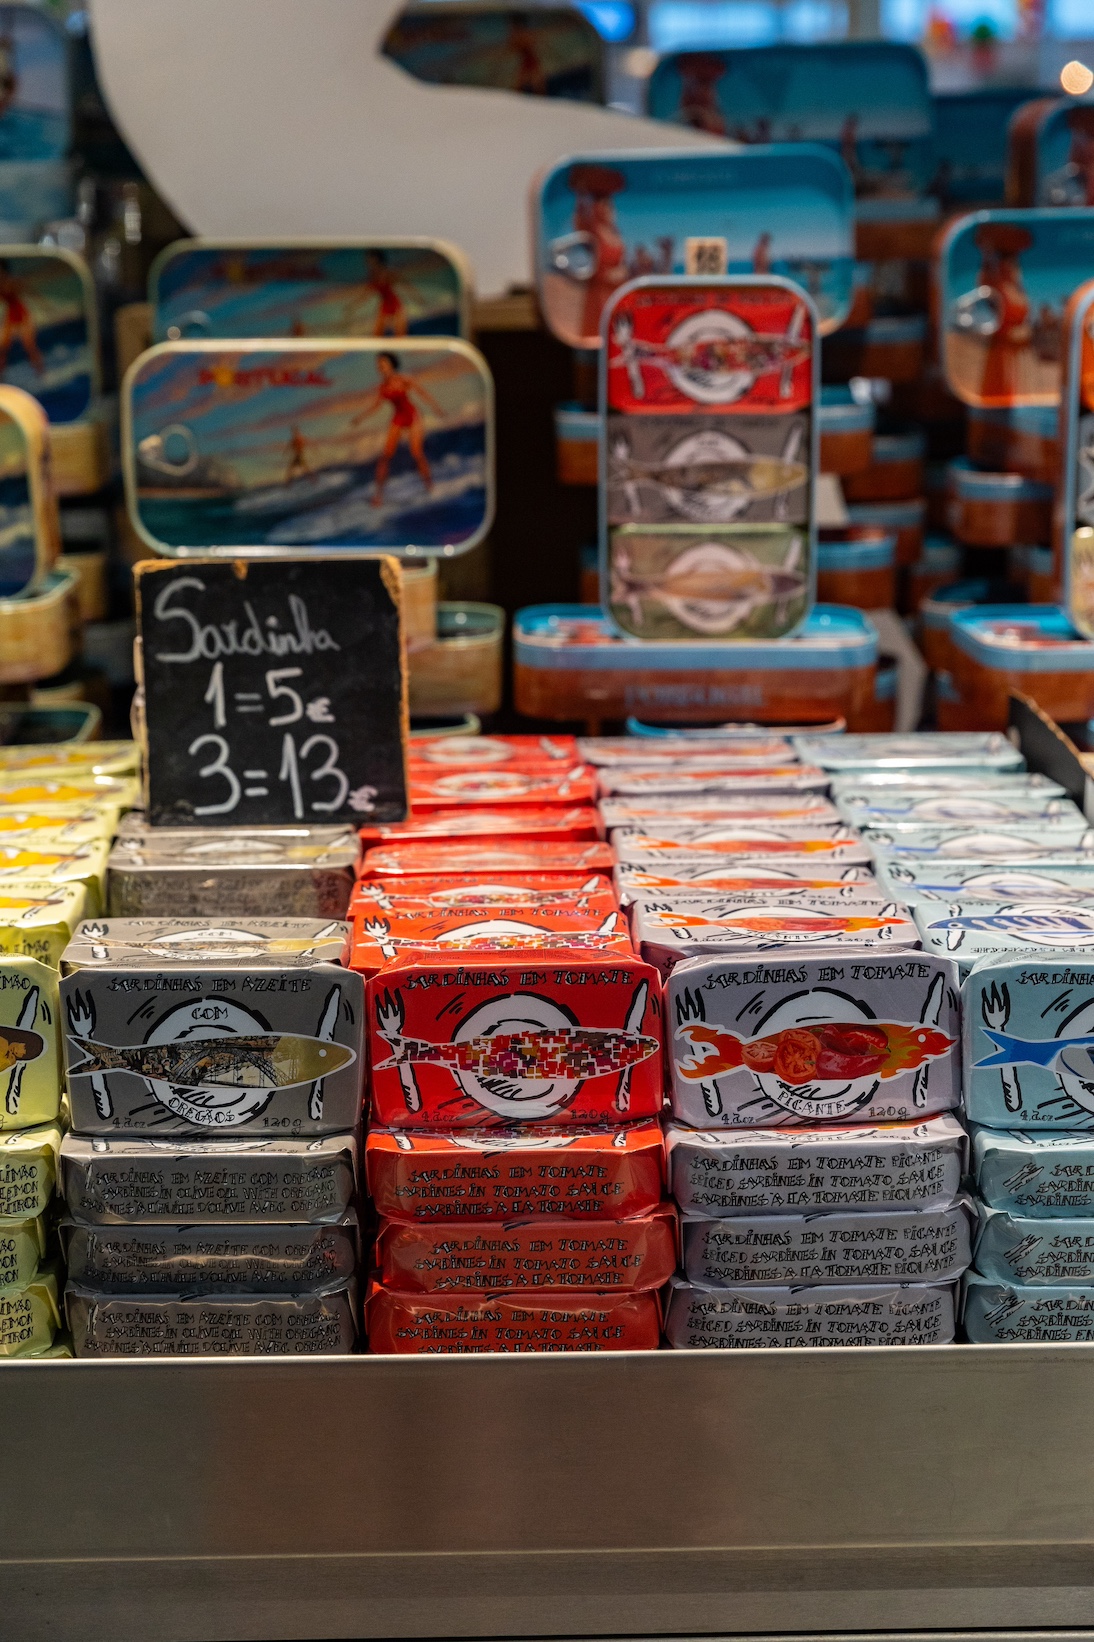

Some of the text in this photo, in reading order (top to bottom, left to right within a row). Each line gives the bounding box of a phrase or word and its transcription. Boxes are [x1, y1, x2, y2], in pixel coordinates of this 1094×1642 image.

[154, 576, 341, 663] Sardinha
[394, 906, 604, 920] SARDINHAS EM TOMATE
[107, 973, 312, 995] SARDINHAS EM AZEITE
[404, 967, 634, 991] SARDINHAS EM TOMATE
[704, 962, 931, 989] SARDINHAS EM TOMATE
[190, 1005, 230, 1020] COM
[168, 1096, 236, 1123] OREGÃOS
[777, 1090, 847, 1116] PICANTE
[690, 1146, 944, 1172] SARDINHAS EM TOMATE PICANTE
[96, 1168, 164, 1186] SARDINHAS
[171, 1173, 190, 1185] EM
[193, 1168, 247, 1185] AZEITE
[251, 1172, 278, 1185] COM
[410, 1163, 608, 1184] SARDINHAS EM TOMATE
[690, 1164, 945, 1190] SPICED SARDINES IN TOMATO SAUCE
[101, 1185, 159, 1199] SARDINES
[160, 1185, 172, 1199] IN
[176, 1185, 214, 1199] OLIVE
[216, 1187, 237, 1199] OIL
[243, 1186, 279, 1199] WITH
[393, 1181, 625, 1198] SARDINES IN TOMATO SAUCE
[690, 1191, 769, 1207] SARDINES
[787, 1190, 811, 1205] LA
[813, 1189, 880, 1204] TOMATE
[882, 1180, 944, 1202] PIQUANTE
[249, 1200, 286, 1213] AVEC
[412, 1200, 493, 1217] SARDINES
[512, 1201, 535, 1214] LA
[537, 1200, 605, 1214] TOMATE
[1015, 1192, 1092, 1207] SARDINES
[702, 1221, 957, 1246] SARDINHAS EM TOMATE PICANTE
[431, 1236, 628, 1255] SARDINHAS EM TOMATE
[702, 1239, 958, 1264] SPICED SARDINES IN TOMATO SAUCE
[412, 1254, 644, 1270] SARDINES IN TOMATO SAUCE
[704, 1265, 781, 1281] SARDINES
[801, 1264, 823, 1277] LA
[824, 1263, 891, 1277] TOMATE
[894, 1254, 956, 1275] PIQUANTE
[1014, 1263, 1092, 1278] SARDINES
[434, 1271, 513, 1289] SARDINES
[531, 1273, 554, 1286] LA
[557, 1272, 624, 1286] TOMATE
[688, 1296, 942, 1317] SARDINHAS EM TOMATE PICANTE
[100, 1309, 170, 1326] SARDINHAS
[177, 1312, 195, 1324] EM
[200, 1309, 250, 1326] AZEITE
[255, 1312, 282, 1325] COM
[410, 1307, 609, 1326] SARDINHAS EM TOMATE
[687, 1313, 942, 1333] SPICED SARDINES IN TOMATO SAUCE
[1017, 1312, 1094, 1328] SARDINES
[105, 1325, 164, 1339] SARDINES
[165, 1325, 177, 1339] IN
[182, 1325, 219, 1340] OLIVE
[221, 1328, 242, 1340] OIL
[249, 1327, 282, 1340] WITH
[396, 1324, 626, 1340] SARDINES IN TOMATO SAUCE
[995, 1326, 1072, 1341] SARDINES
[253, 1340, 290, 1354] AVEC
